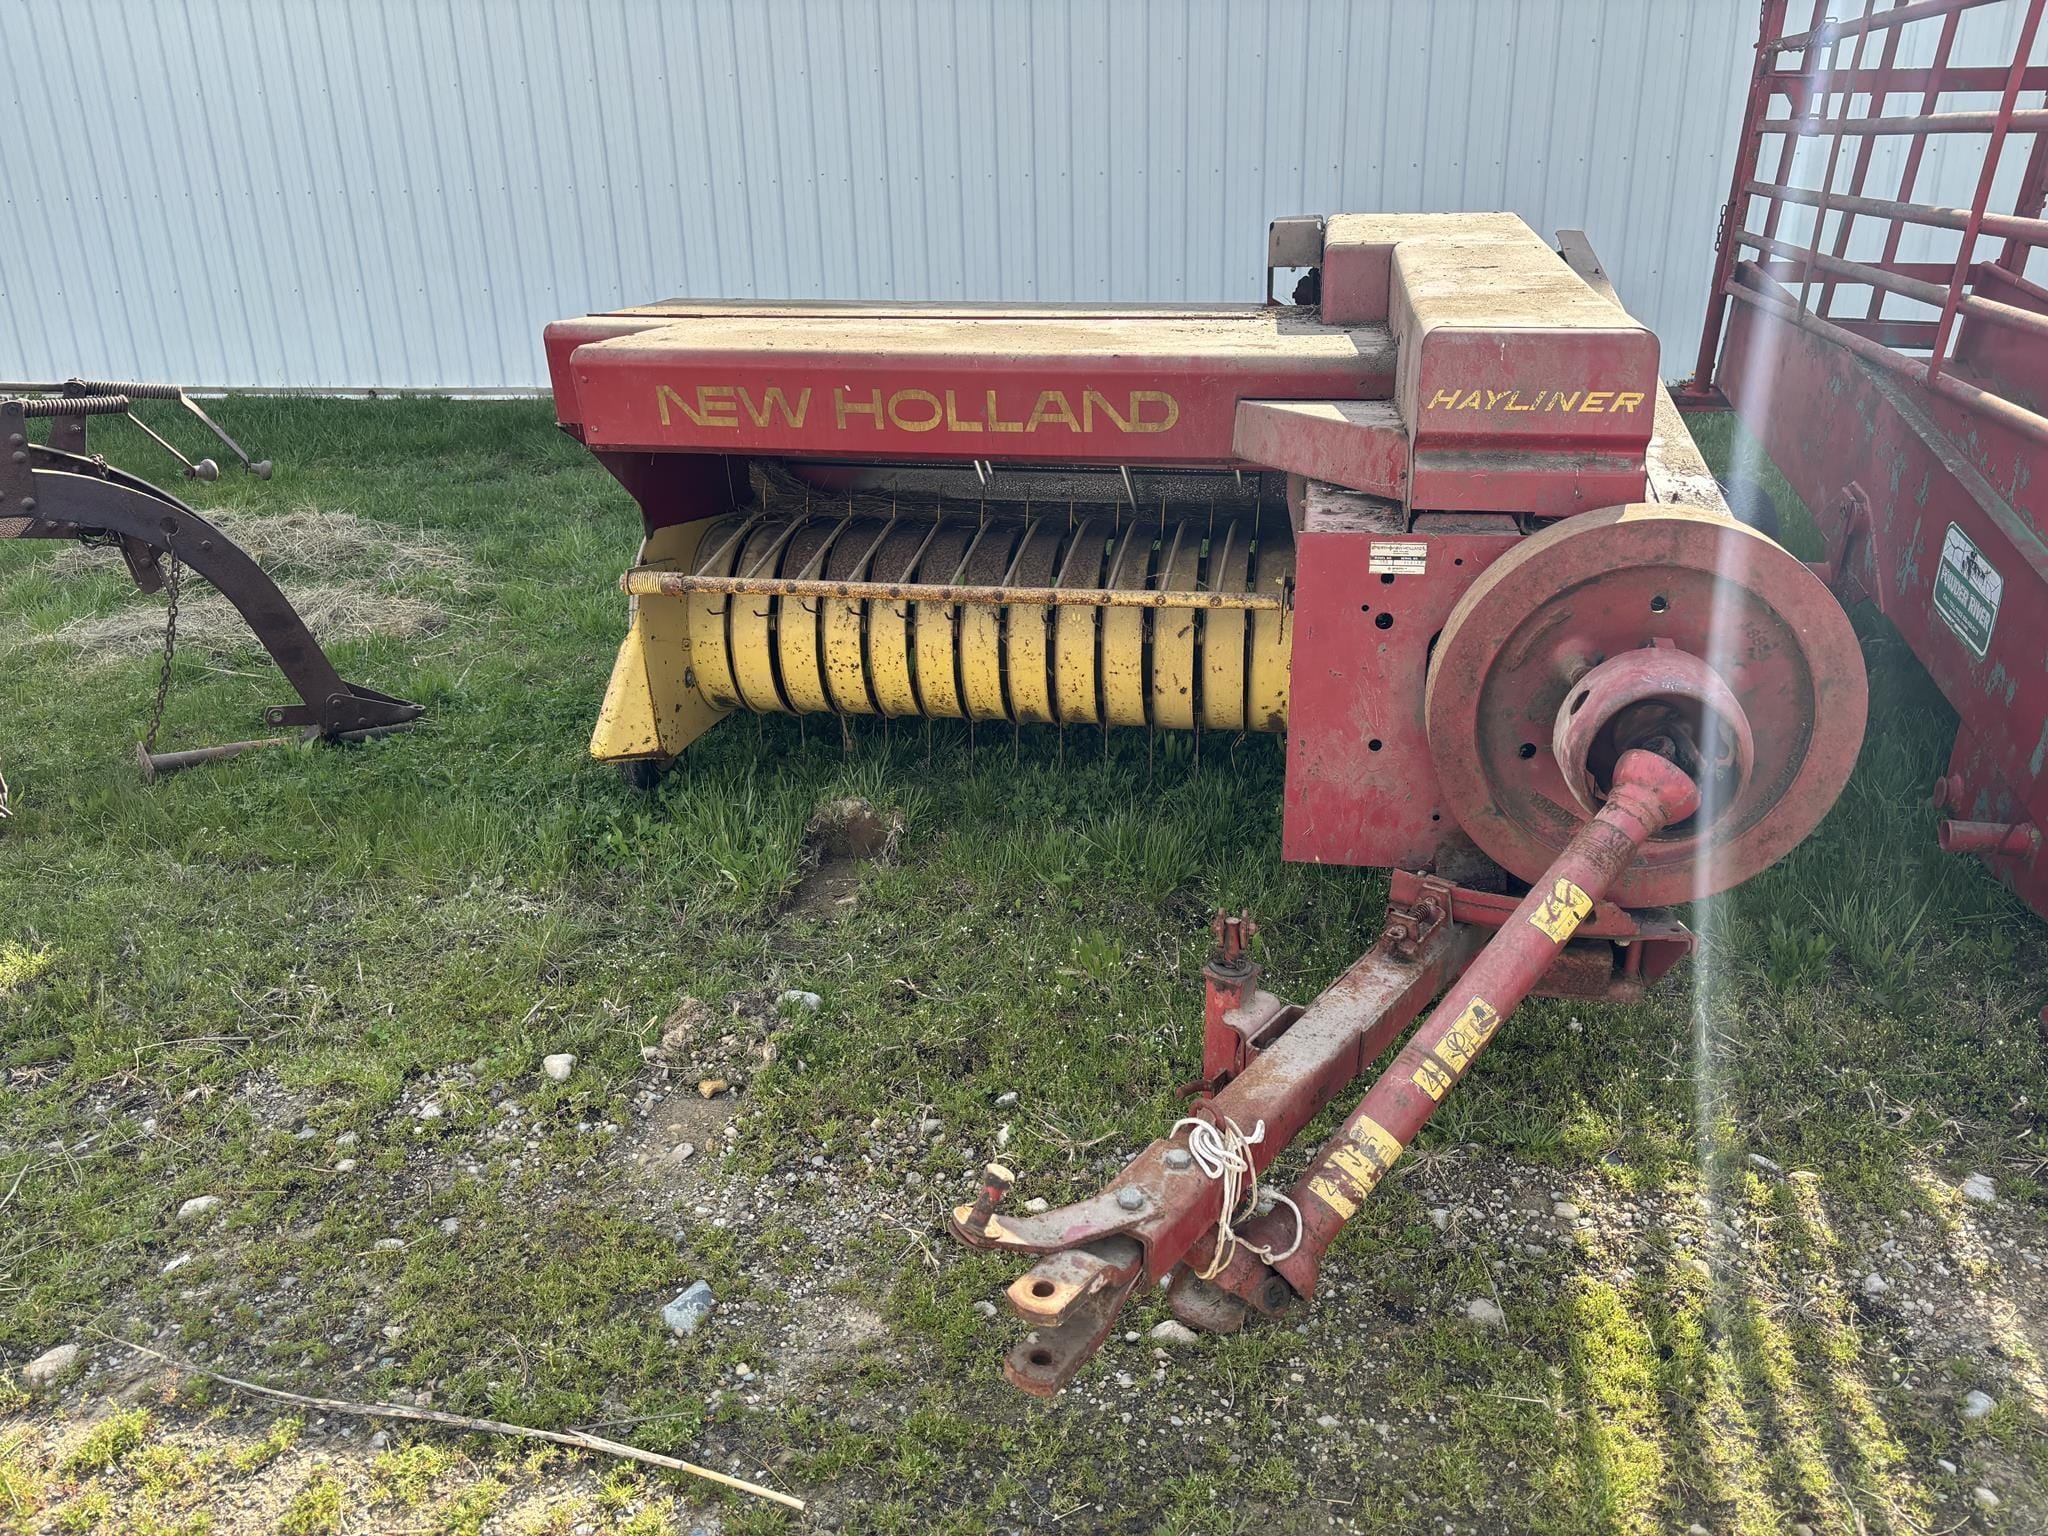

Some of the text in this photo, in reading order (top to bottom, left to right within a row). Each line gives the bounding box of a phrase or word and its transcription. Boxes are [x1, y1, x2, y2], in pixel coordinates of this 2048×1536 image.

[655, 384, 1180, 433] NEW HOLLAND
[1427, 389, 1645, 413] HAYLINER
[1940, 563, 1970, 609] POWDER
[1967, 593, 1991, 632] RIVER
